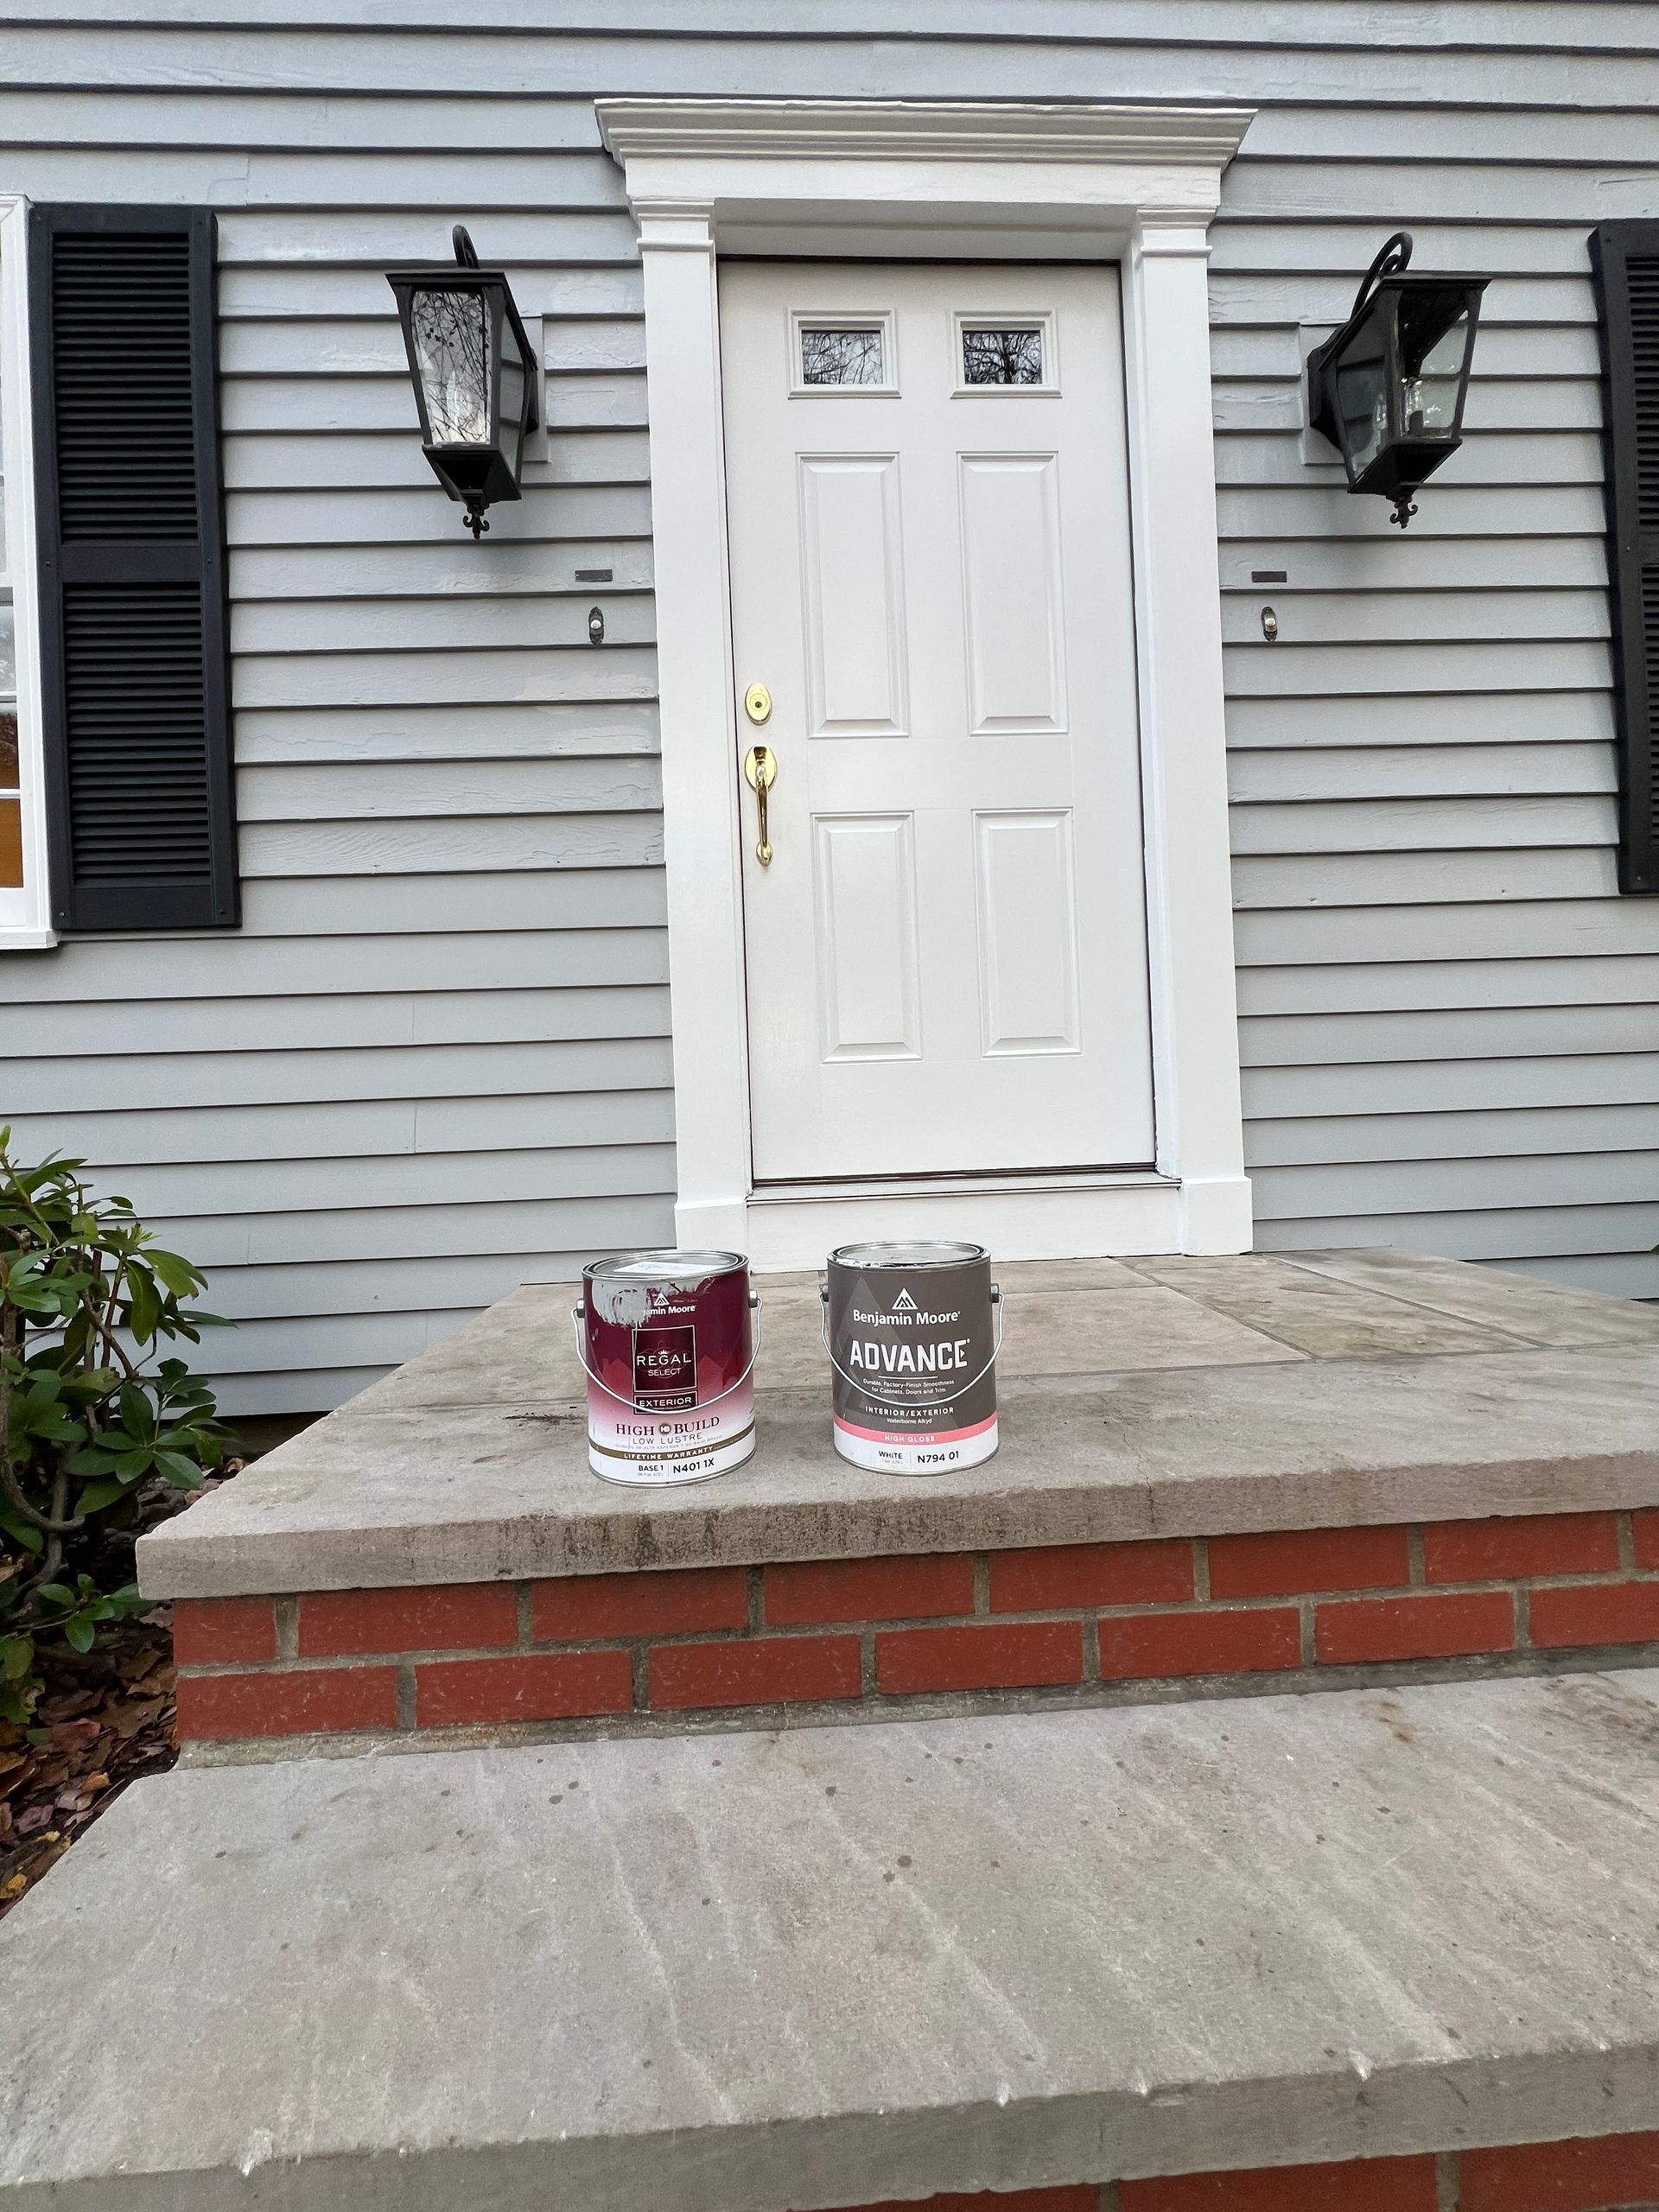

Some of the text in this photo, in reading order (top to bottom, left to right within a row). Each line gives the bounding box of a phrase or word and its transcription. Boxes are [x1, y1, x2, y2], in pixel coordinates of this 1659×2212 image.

[668, 1305, 696, 1314] Moore
[853, 1309, 959, 1327] Benjamin Moore
[637, 1353, 692, 1366] REGAL
[849, 1338, 968, 1372] ADVANCE
[648, 1368, 682, 1376] SELECT
[639, 1396, 692, 1408] EXTERIOR
[865, 1405, 955, 1417] INTERIOR/EXTERIOR
[616, 1423, 654, 1436] HIGH
[674, 1416, 720, 1434] BUILD
[660, 1432, 702, 1445] LUSTRE
[666, 1446, 714, 1459] WARRANTY
[878, 1451, 903, 1459] WHITE
[918, 1451, 959, 1464] N794 01
[673, 1457, 715, 1474] N401 1X
